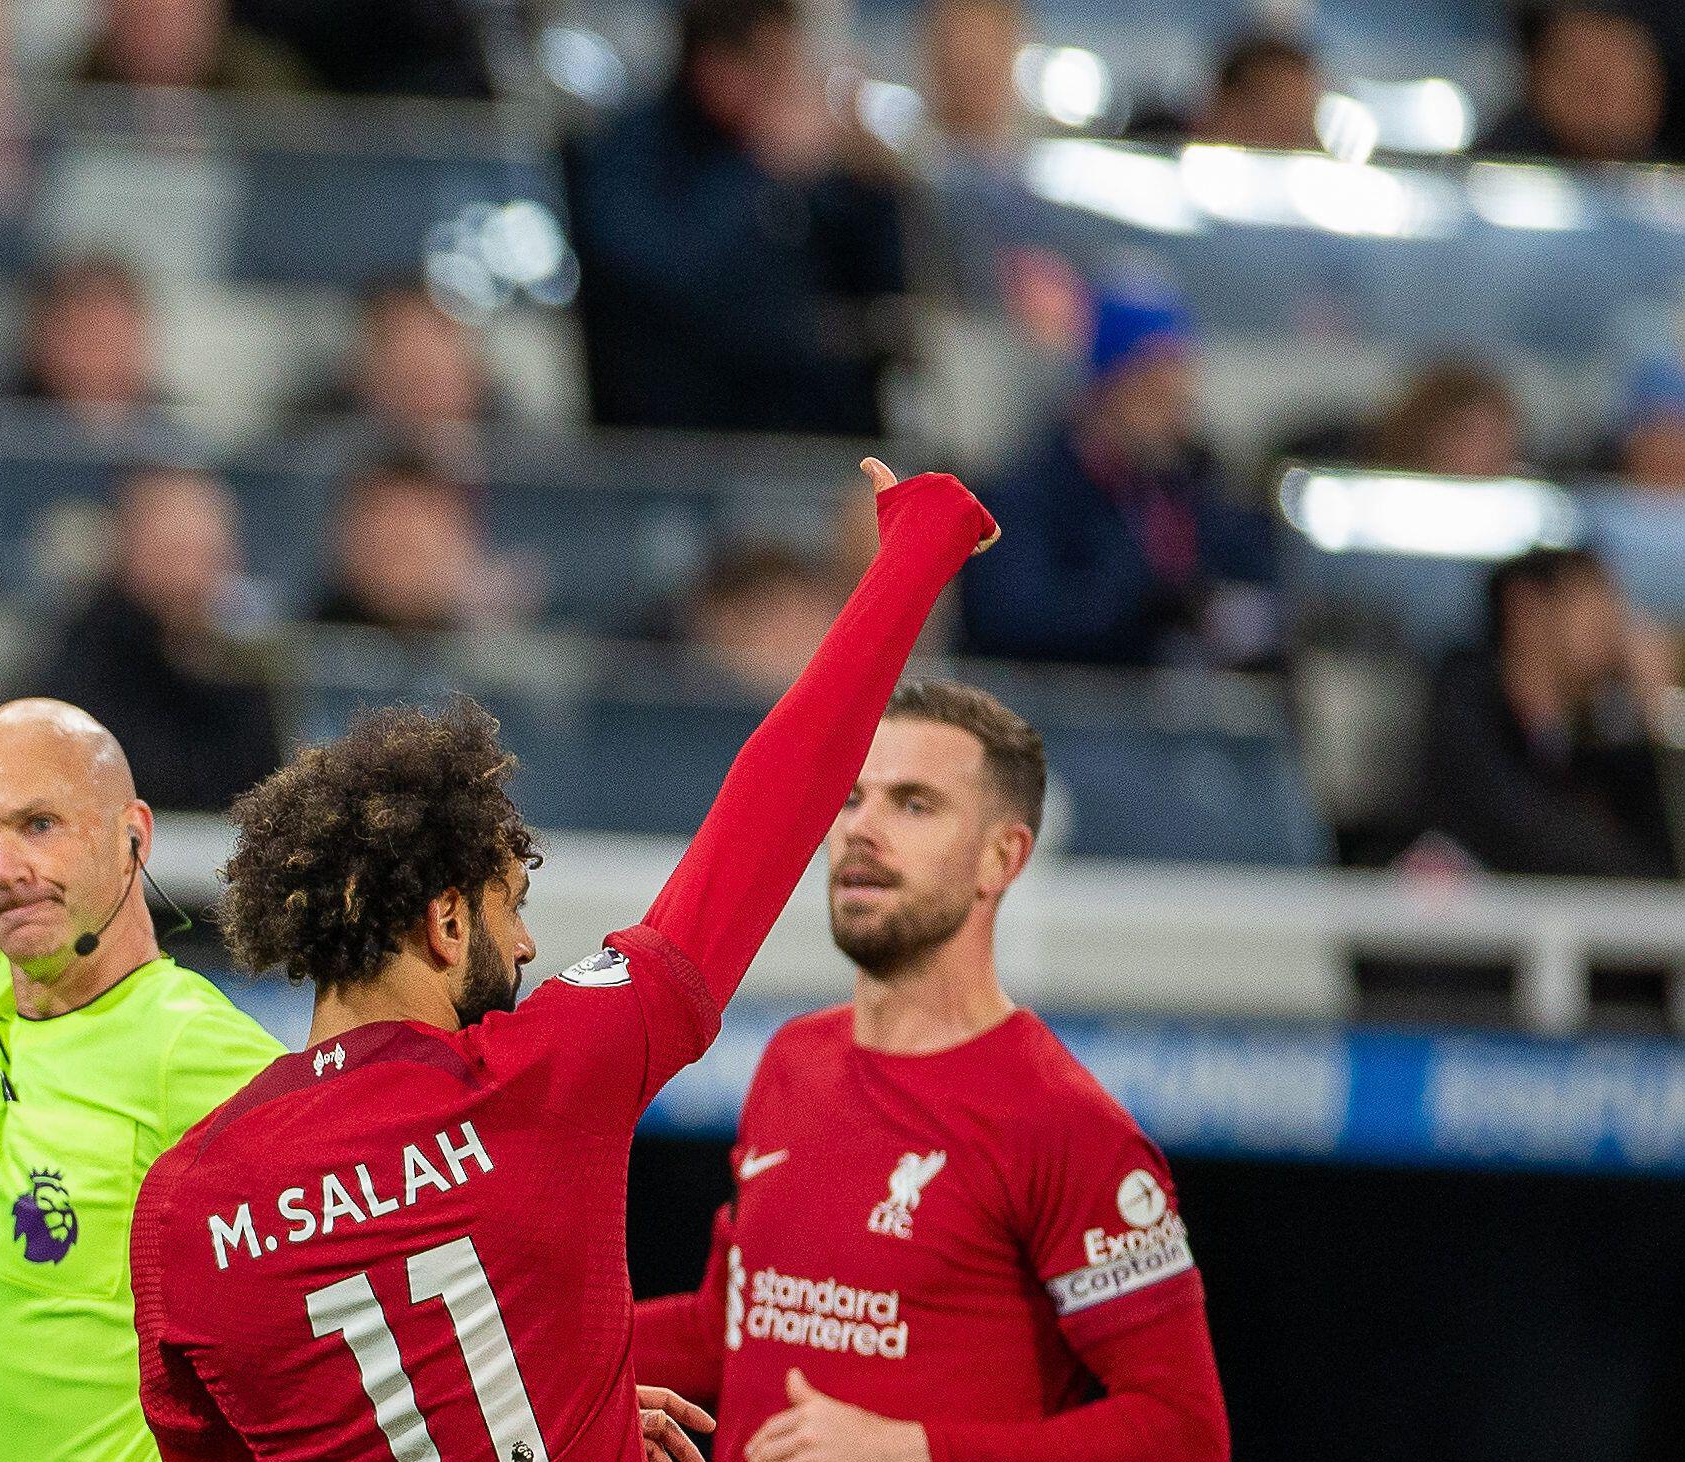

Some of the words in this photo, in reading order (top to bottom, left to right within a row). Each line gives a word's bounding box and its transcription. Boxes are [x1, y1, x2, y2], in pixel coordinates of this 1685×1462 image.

[208, 1120, 495, 1270] M.SALAH
[751, 1266, 900, 1326] standard
[746, 1302, 909, 1360] chartered
